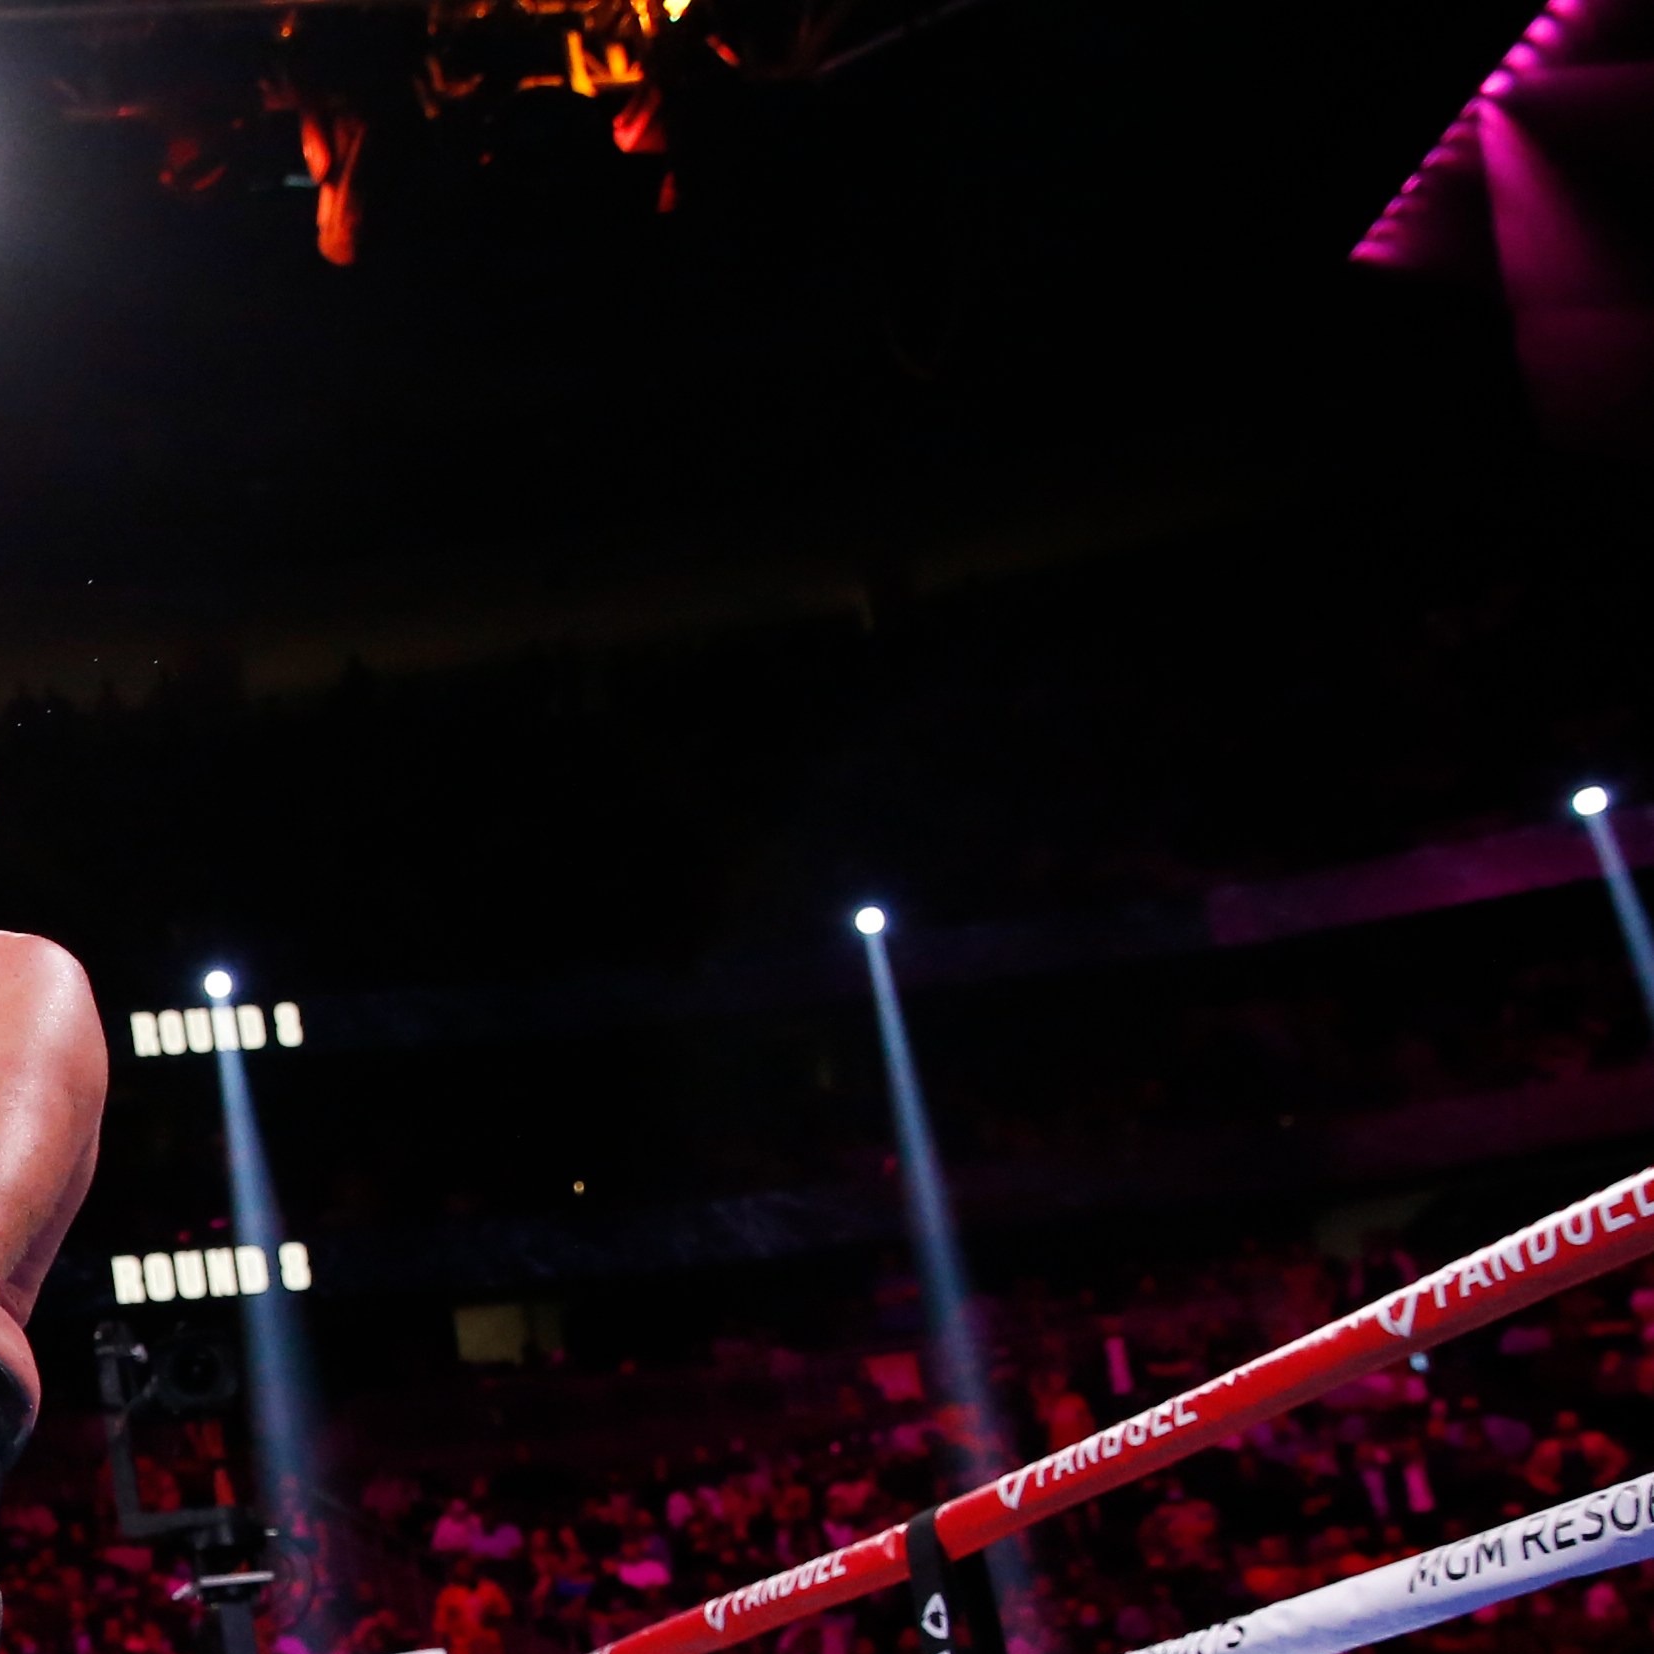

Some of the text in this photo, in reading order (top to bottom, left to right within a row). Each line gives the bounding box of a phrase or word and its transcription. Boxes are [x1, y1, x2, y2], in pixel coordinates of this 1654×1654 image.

[129, 1004, 268, 1057] ROUND
[111, 1244, 269, 1305] ROUND
[1409, 1537, 1507, 1594] MGM
